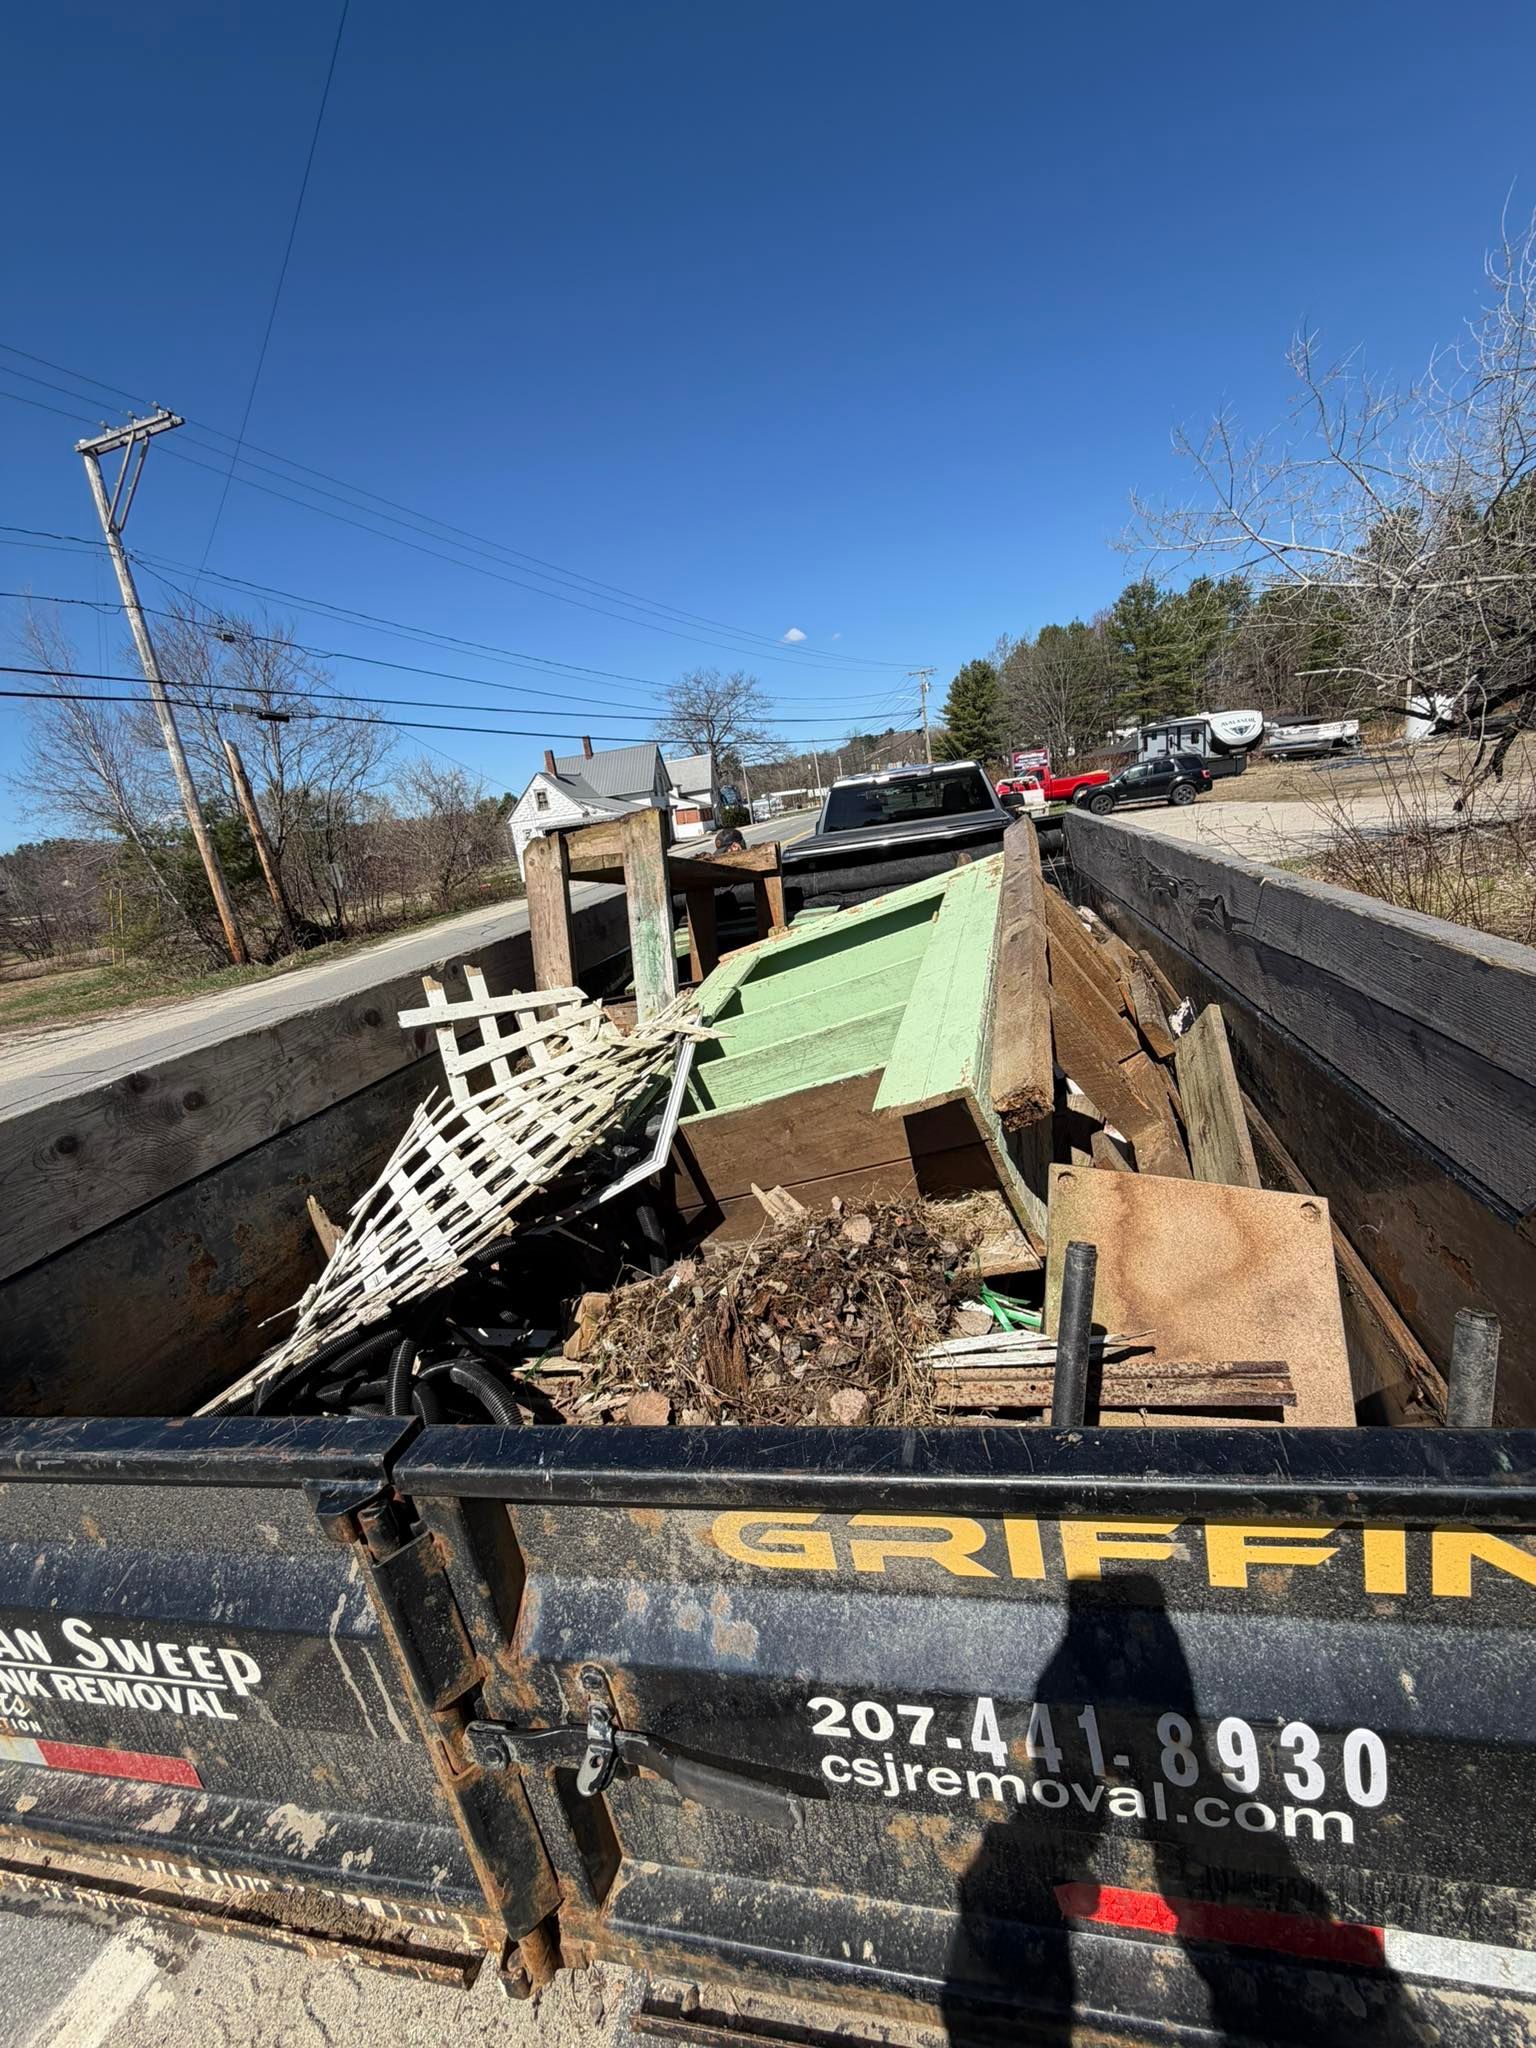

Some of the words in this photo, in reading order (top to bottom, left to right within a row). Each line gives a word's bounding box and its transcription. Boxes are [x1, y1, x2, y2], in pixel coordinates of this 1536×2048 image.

[712, 1507, 1536, 1598] GRIFFIN
[0, 1716, 43, 1733] TION
[50, 1673, 239, 1721] REMOVAL
[820, 1752, 1355, 1845] csjremoval.com
